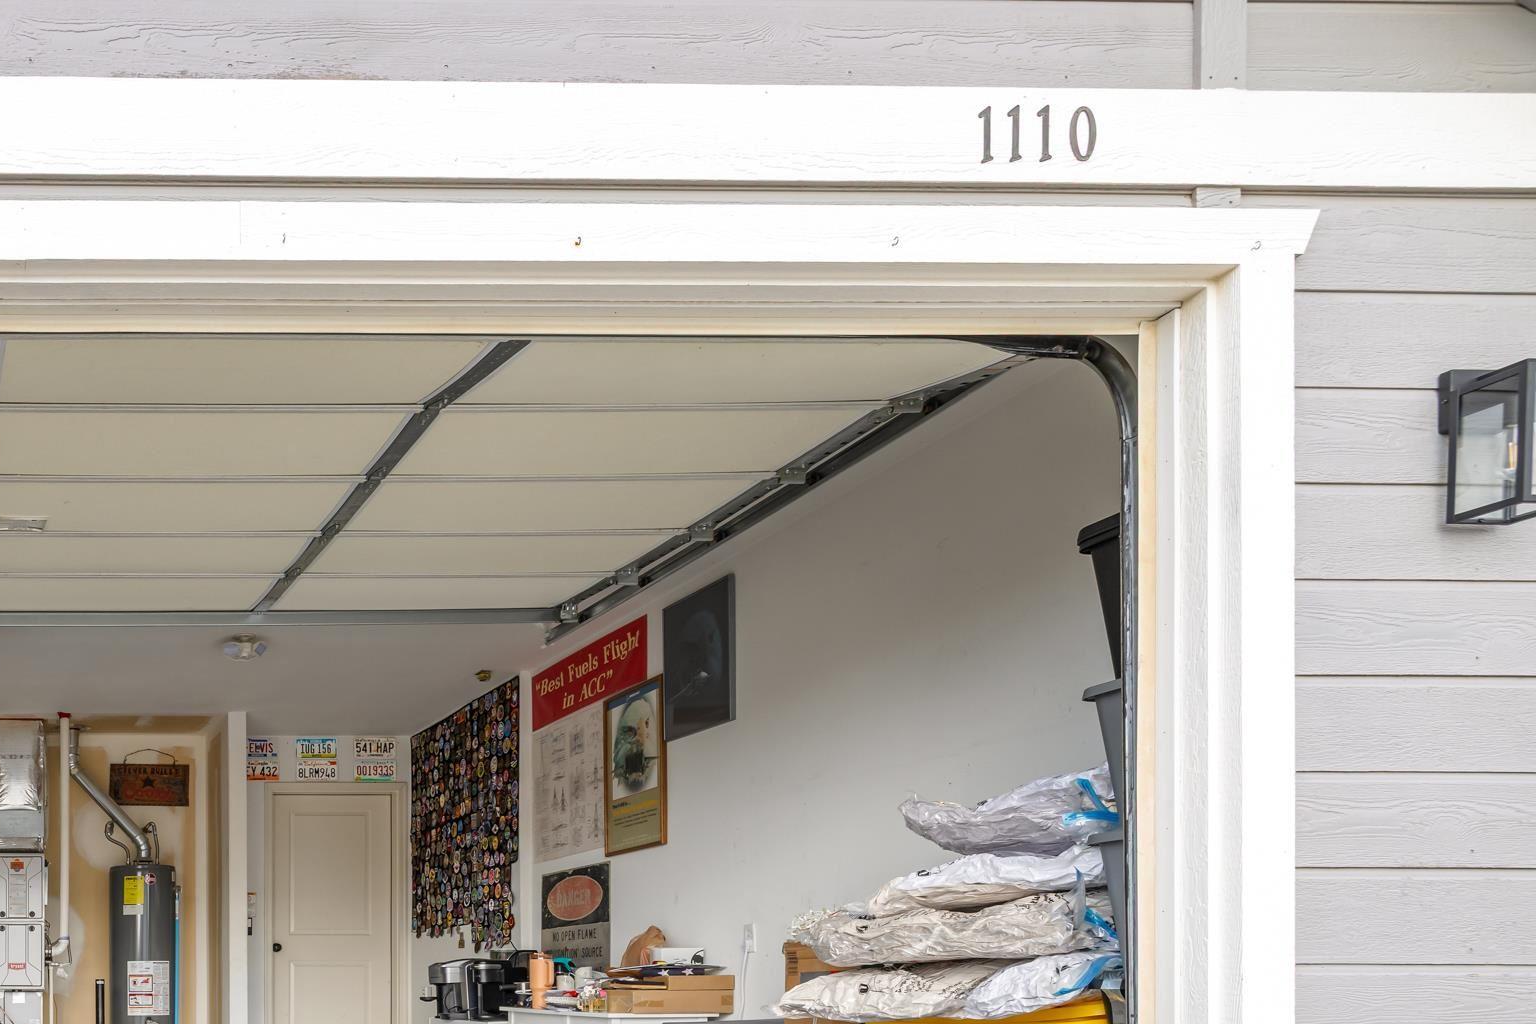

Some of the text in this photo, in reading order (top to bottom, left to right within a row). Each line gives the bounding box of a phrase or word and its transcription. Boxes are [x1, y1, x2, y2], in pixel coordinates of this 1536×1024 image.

[977, 104, 1098, 164] 1110
[567, 652, 600, 683] Fuels
[602, 629, 641, 665] Flight
[561, 691, 575, 710] in
[248, 742, 274, 754] ELVIS
[317, 743, 332, 755] 156
[355, 742, 395, 754] 541 HAP
[259, 766, 278, 778] 432
[552, 927, 598, 942] NO OPEN FLAME
[581, 945, 604, 958] SOURCE
